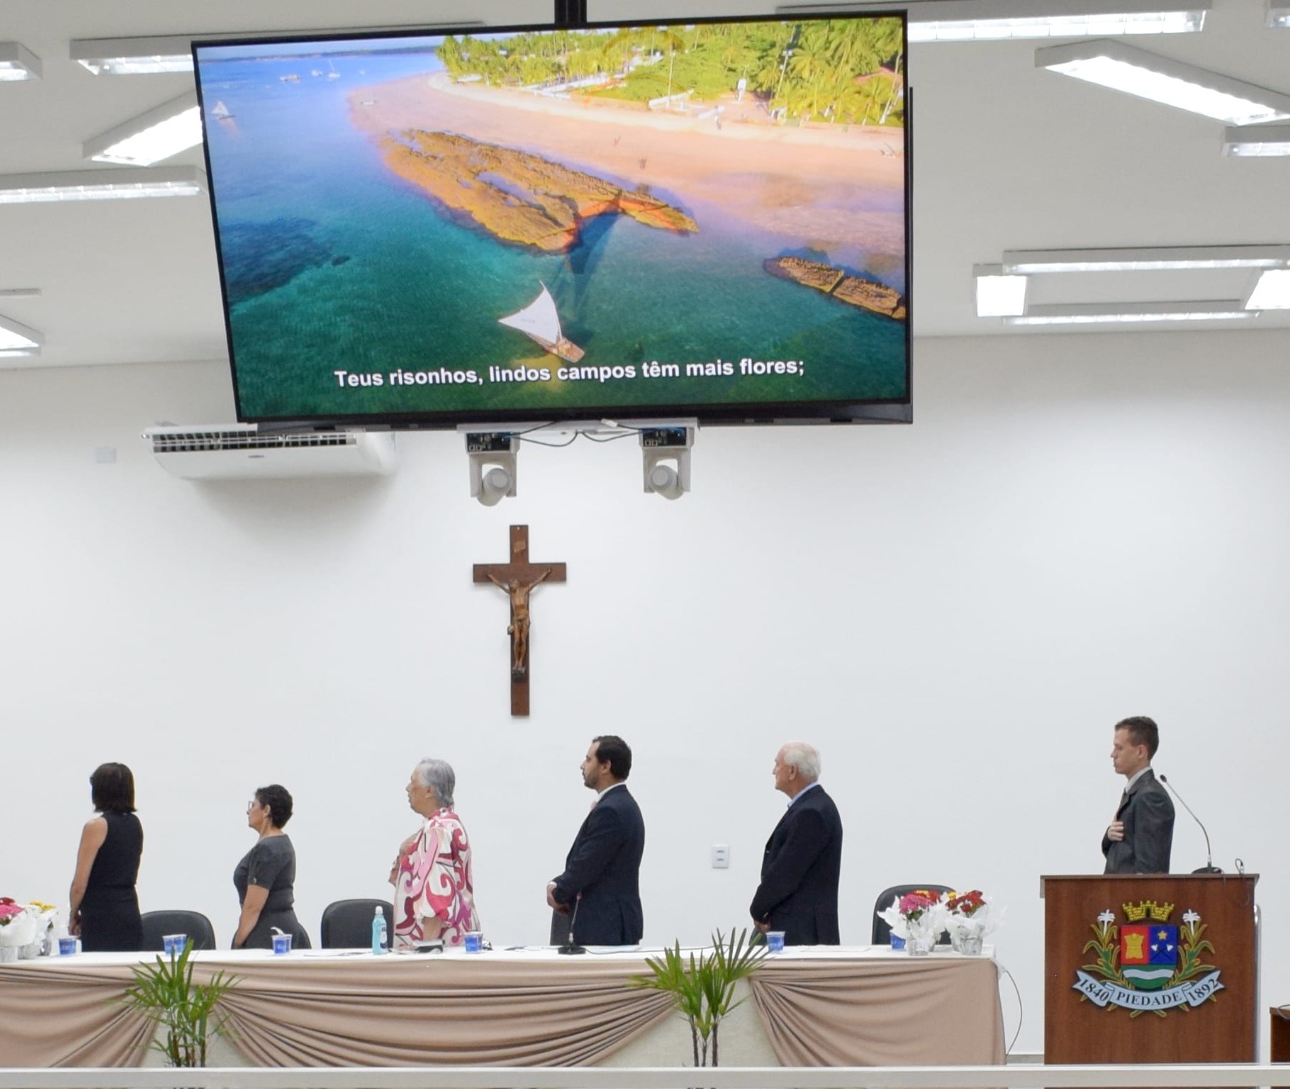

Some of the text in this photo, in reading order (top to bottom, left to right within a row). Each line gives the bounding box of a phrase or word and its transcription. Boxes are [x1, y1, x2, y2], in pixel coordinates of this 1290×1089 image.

[334, 358, 805, 387] Teus risonhos, lindos campos têm mais flores;
[1079, 978, 1219, 1006] 1840 PIEDADE 1892
